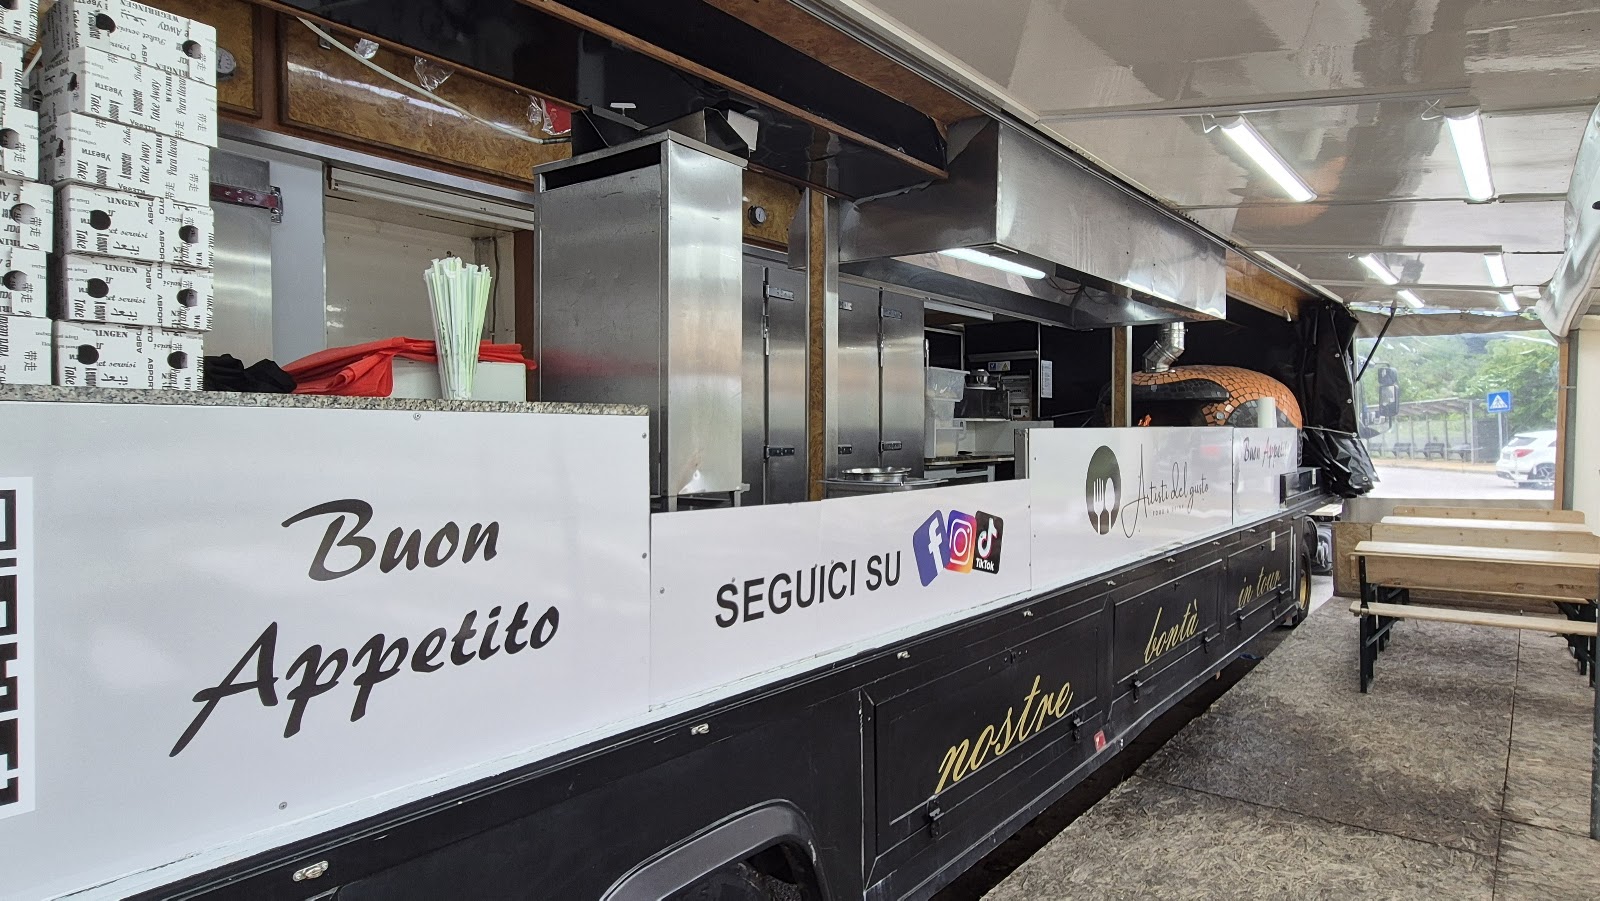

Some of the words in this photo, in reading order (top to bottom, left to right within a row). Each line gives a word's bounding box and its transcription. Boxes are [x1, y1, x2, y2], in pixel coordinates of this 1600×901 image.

[81, 147, 112, 162] Увезти
[140, 141, 151, 165] Away
[77, 159, 89, 181] Take
[139, 165, 150, 184] Take
[76, 229, 89, 250] Take
[74, 299, 87, 319] Take
[64, 365, 77, 385] Take
[1121, 443, 1169, 539] Artisti
[1171, 461, 1188, 499] del
[1188, 472, 1209, 515] gusto
[281, 498, 500, 582] Buon
[975, 557, 995, 572] TikTok
[715, 559, 856, 629] SEGUICI
[865, 550, 901, 592] SU
[1143, 598, 1199, 664] bontà
[168, 601, 561, 758] Appetito
[935, 675, 1074, 794] nostre
